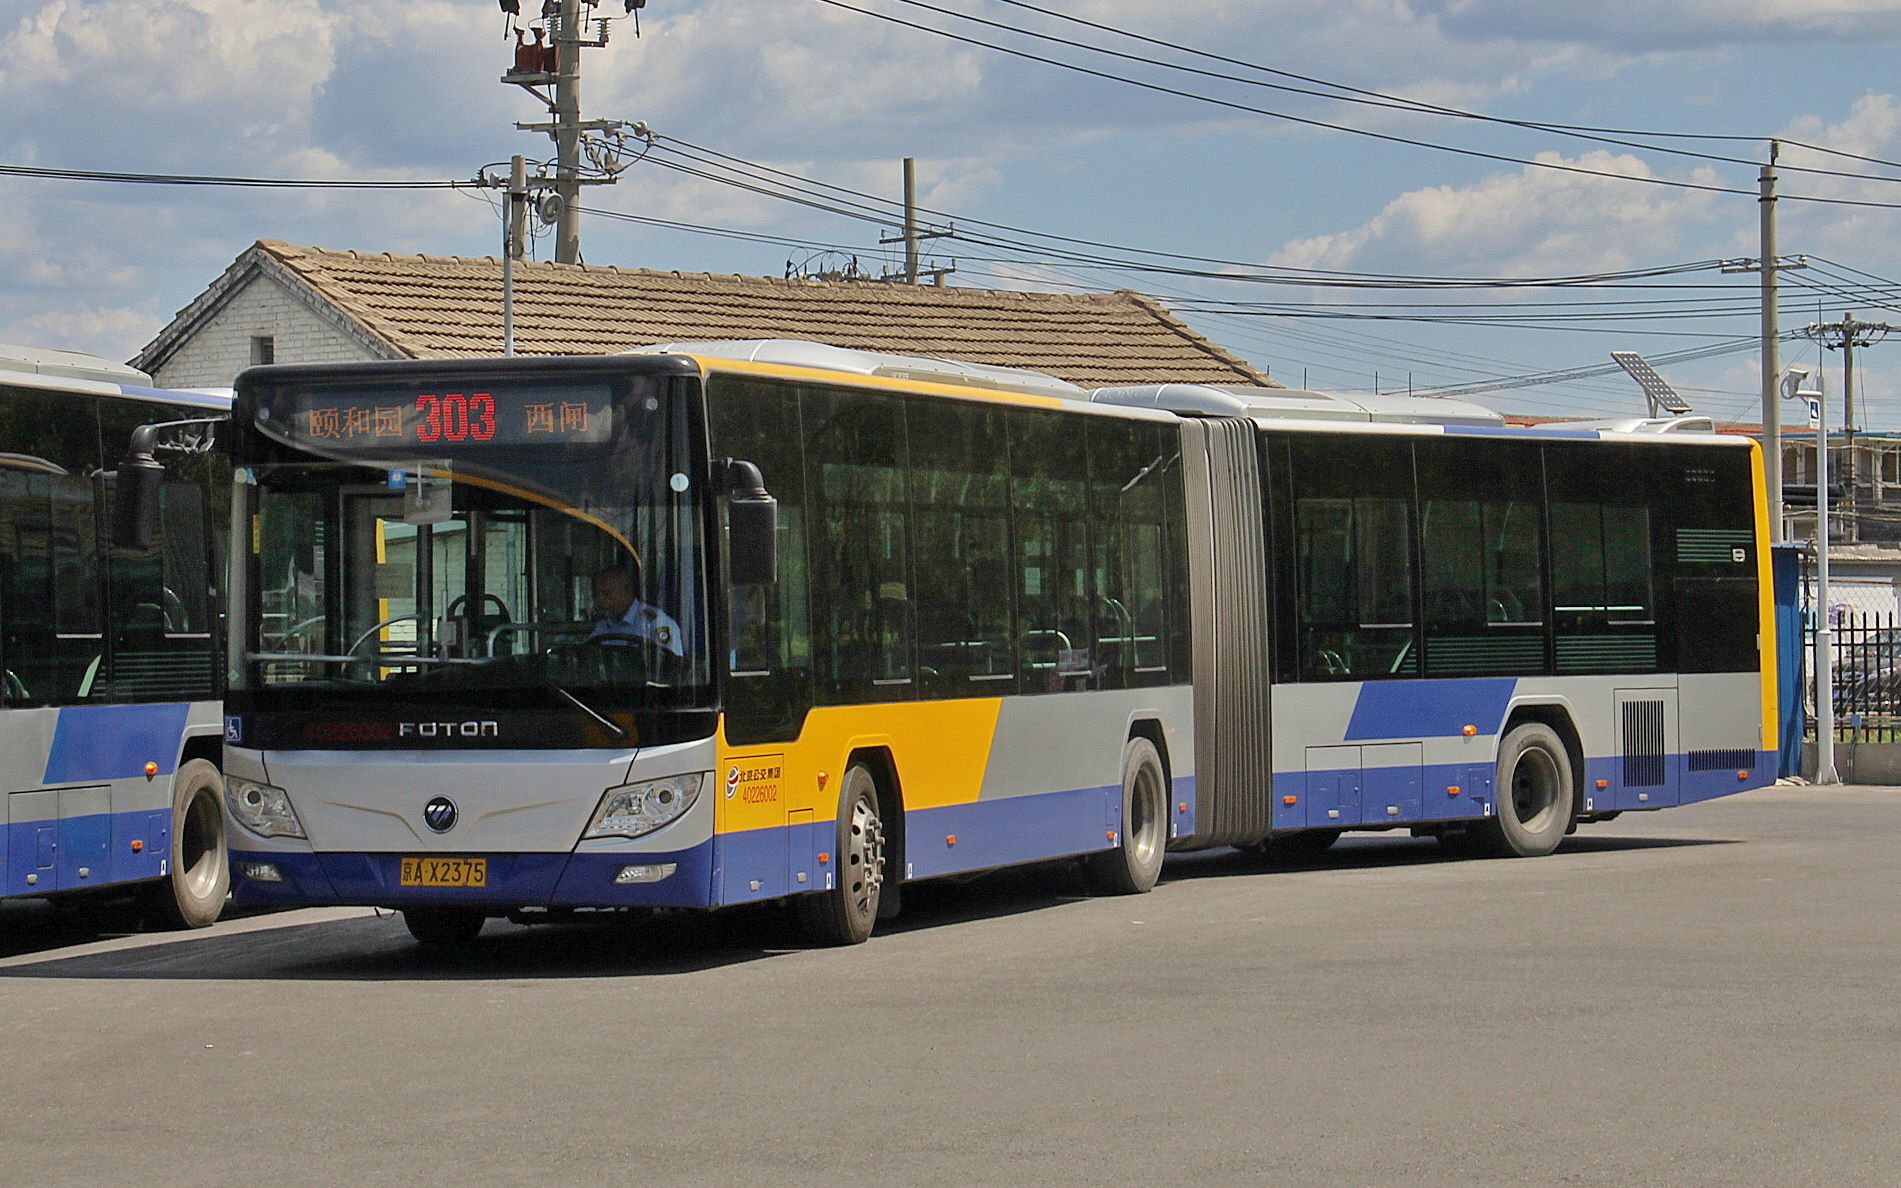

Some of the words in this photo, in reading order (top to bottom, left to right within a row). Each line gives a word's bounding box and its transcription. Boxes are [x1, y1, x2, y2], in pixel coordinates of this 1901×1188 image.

[308, 405, 403, 439] 颐和园
[415, 394, 496, 442] 303
[524, 401, 589, 433] 西闸
[399, 721, 498, 737] FOTON
[742, 784, 777, 804] 40226002
